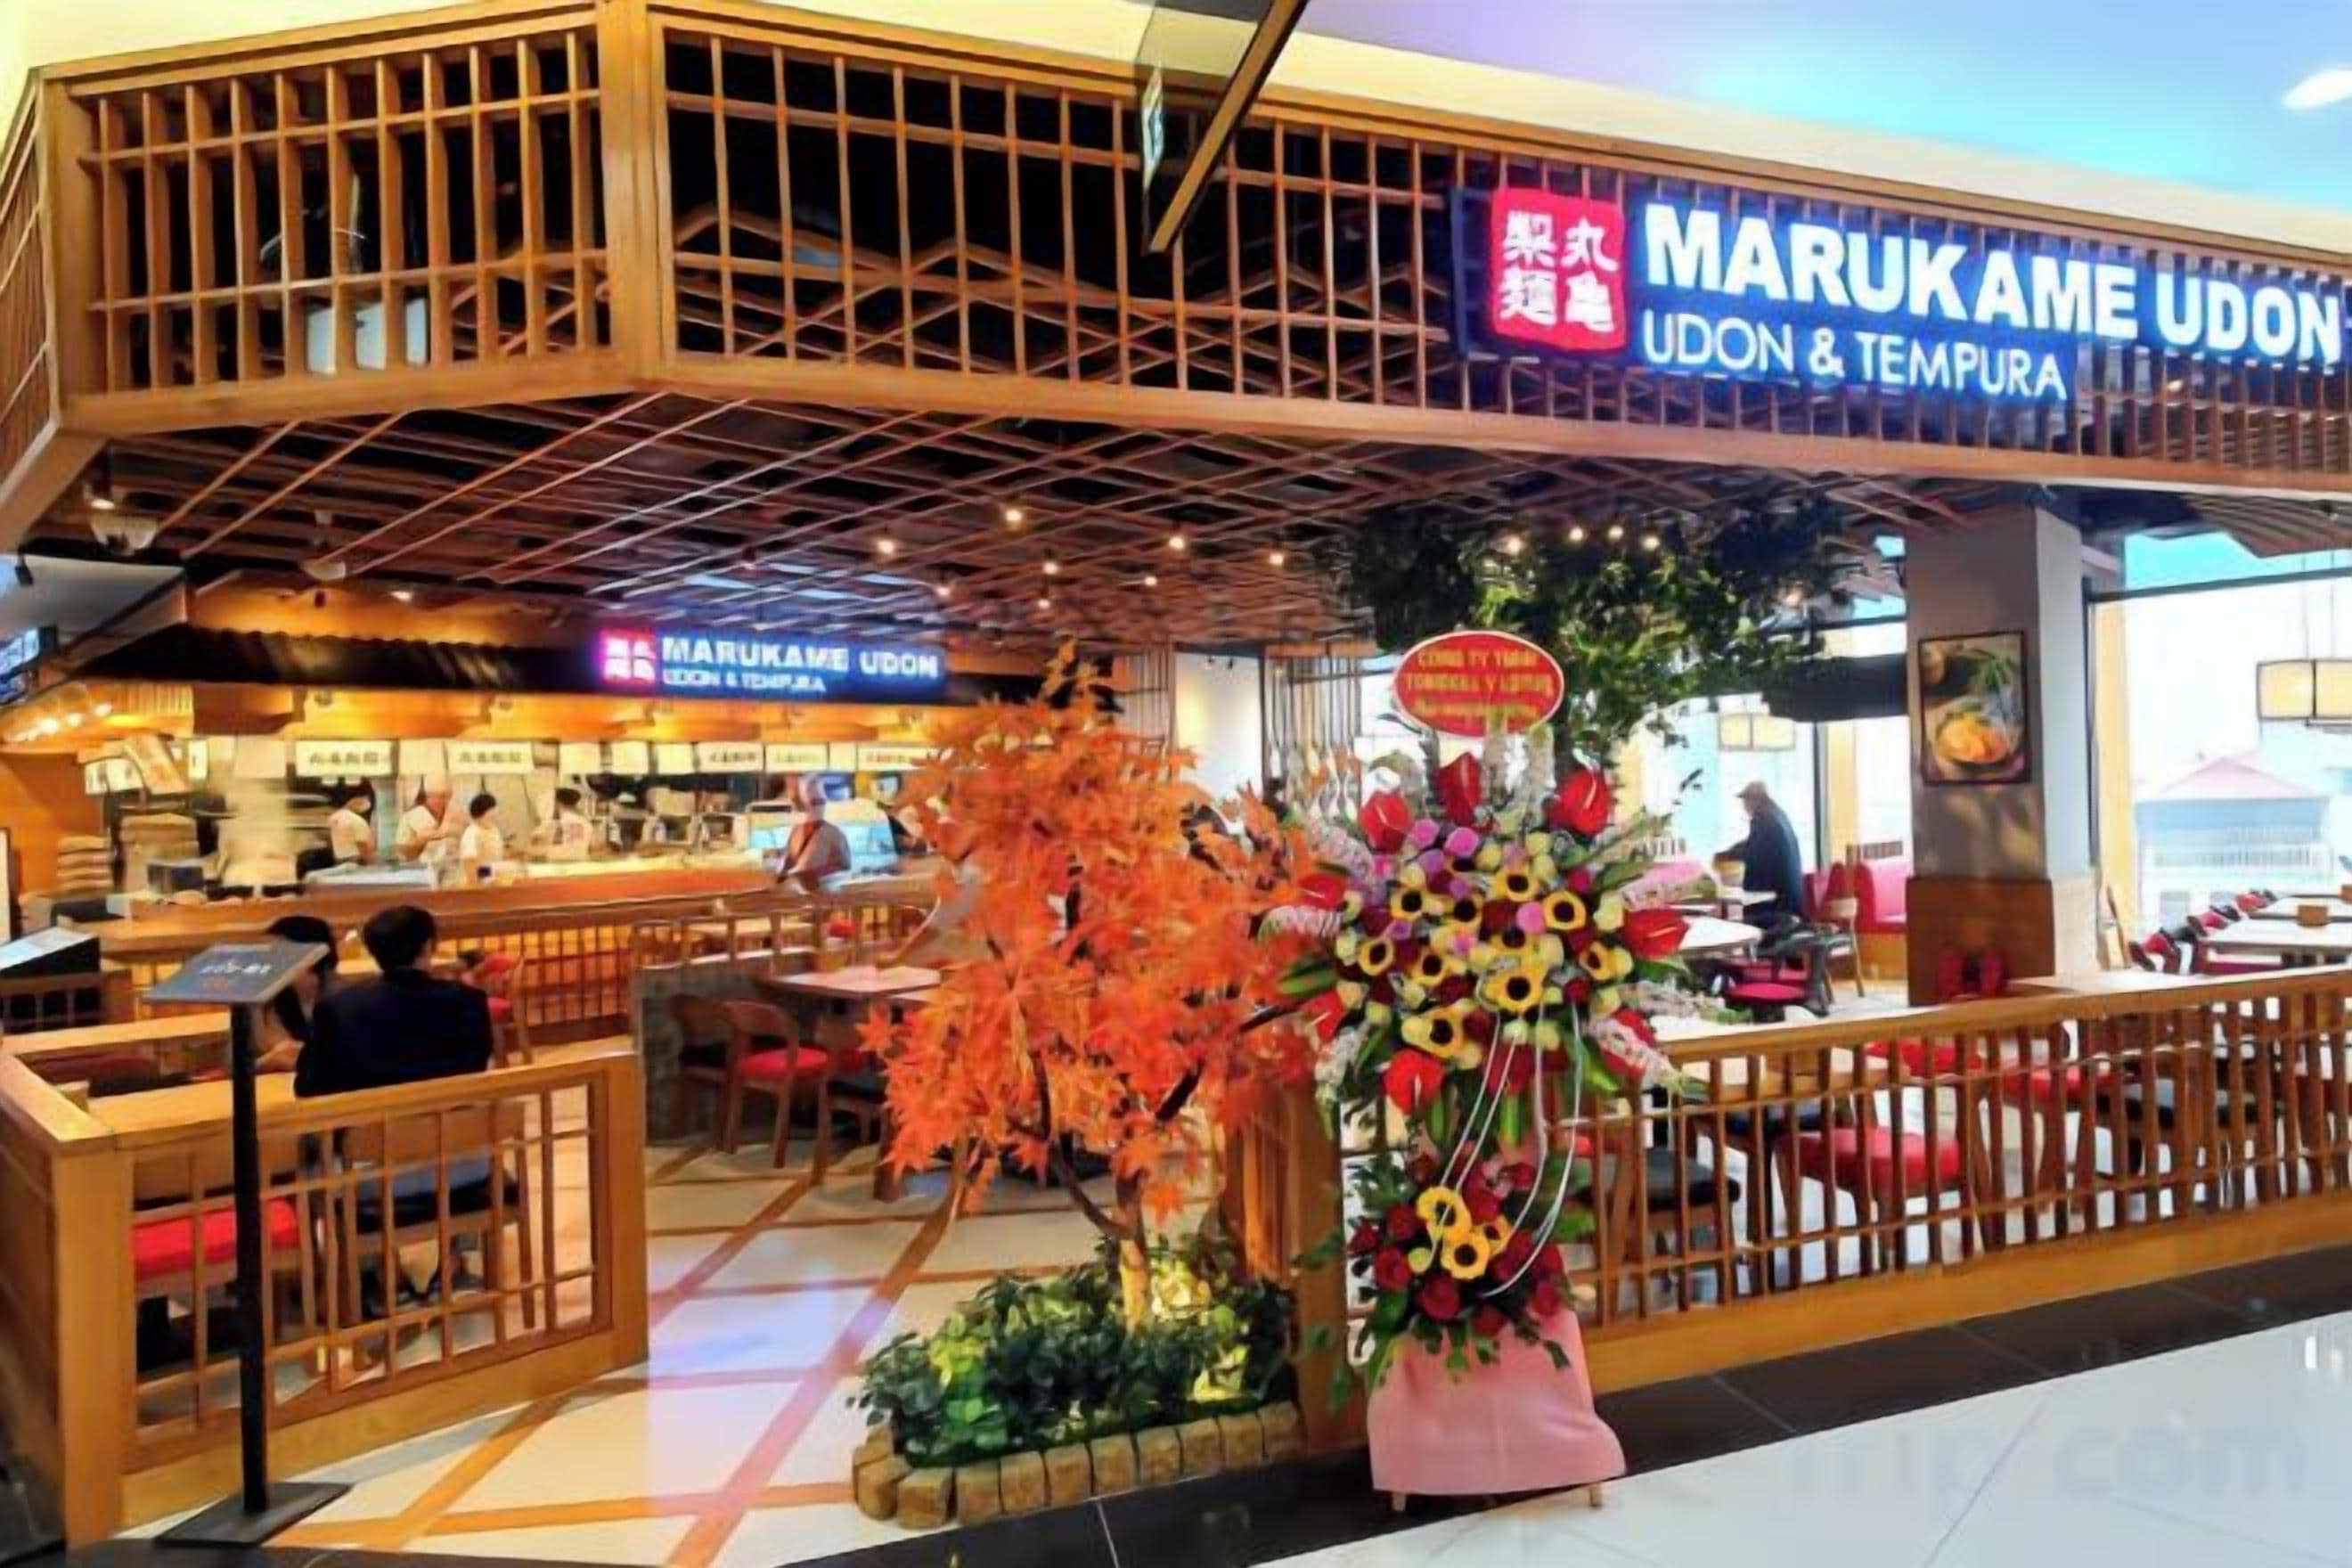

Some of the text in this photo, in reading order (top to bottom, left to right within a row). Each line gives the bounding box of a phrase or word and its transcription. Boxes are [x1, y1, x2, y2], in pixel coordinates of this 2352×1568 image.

[1645, 203, 2341, 366] MARUKAME UDON
[1643, 308, 2067, 400] UDON & TEMPURA
[662, 636, 849, 673] MARUKAME
[859, 650, 939, 679] UDON
